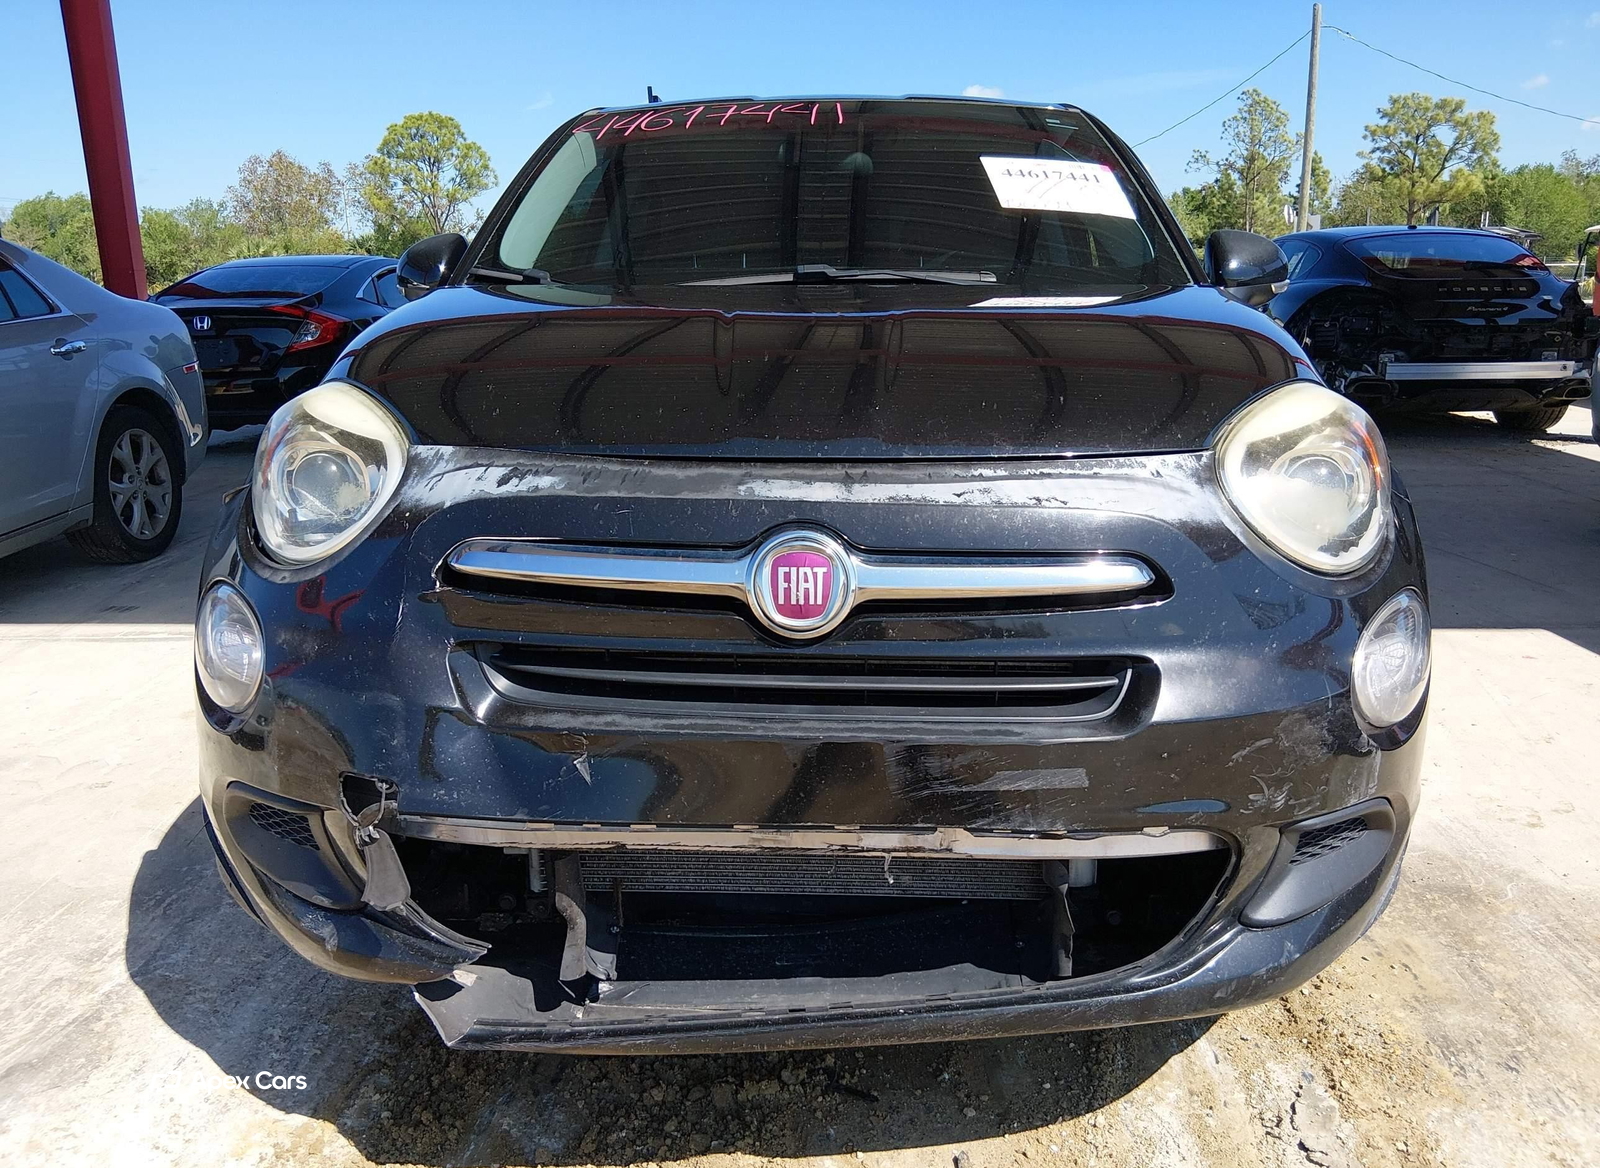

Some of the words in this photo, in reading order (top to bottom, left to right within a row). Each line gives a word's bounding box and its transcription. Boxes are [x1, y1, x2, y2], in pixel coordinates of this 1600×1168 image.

[571, 102, 844, 140] 44617441
[1001, 168, 1100, 183] 44617441
[777, 566, 828, 605] FIAT
